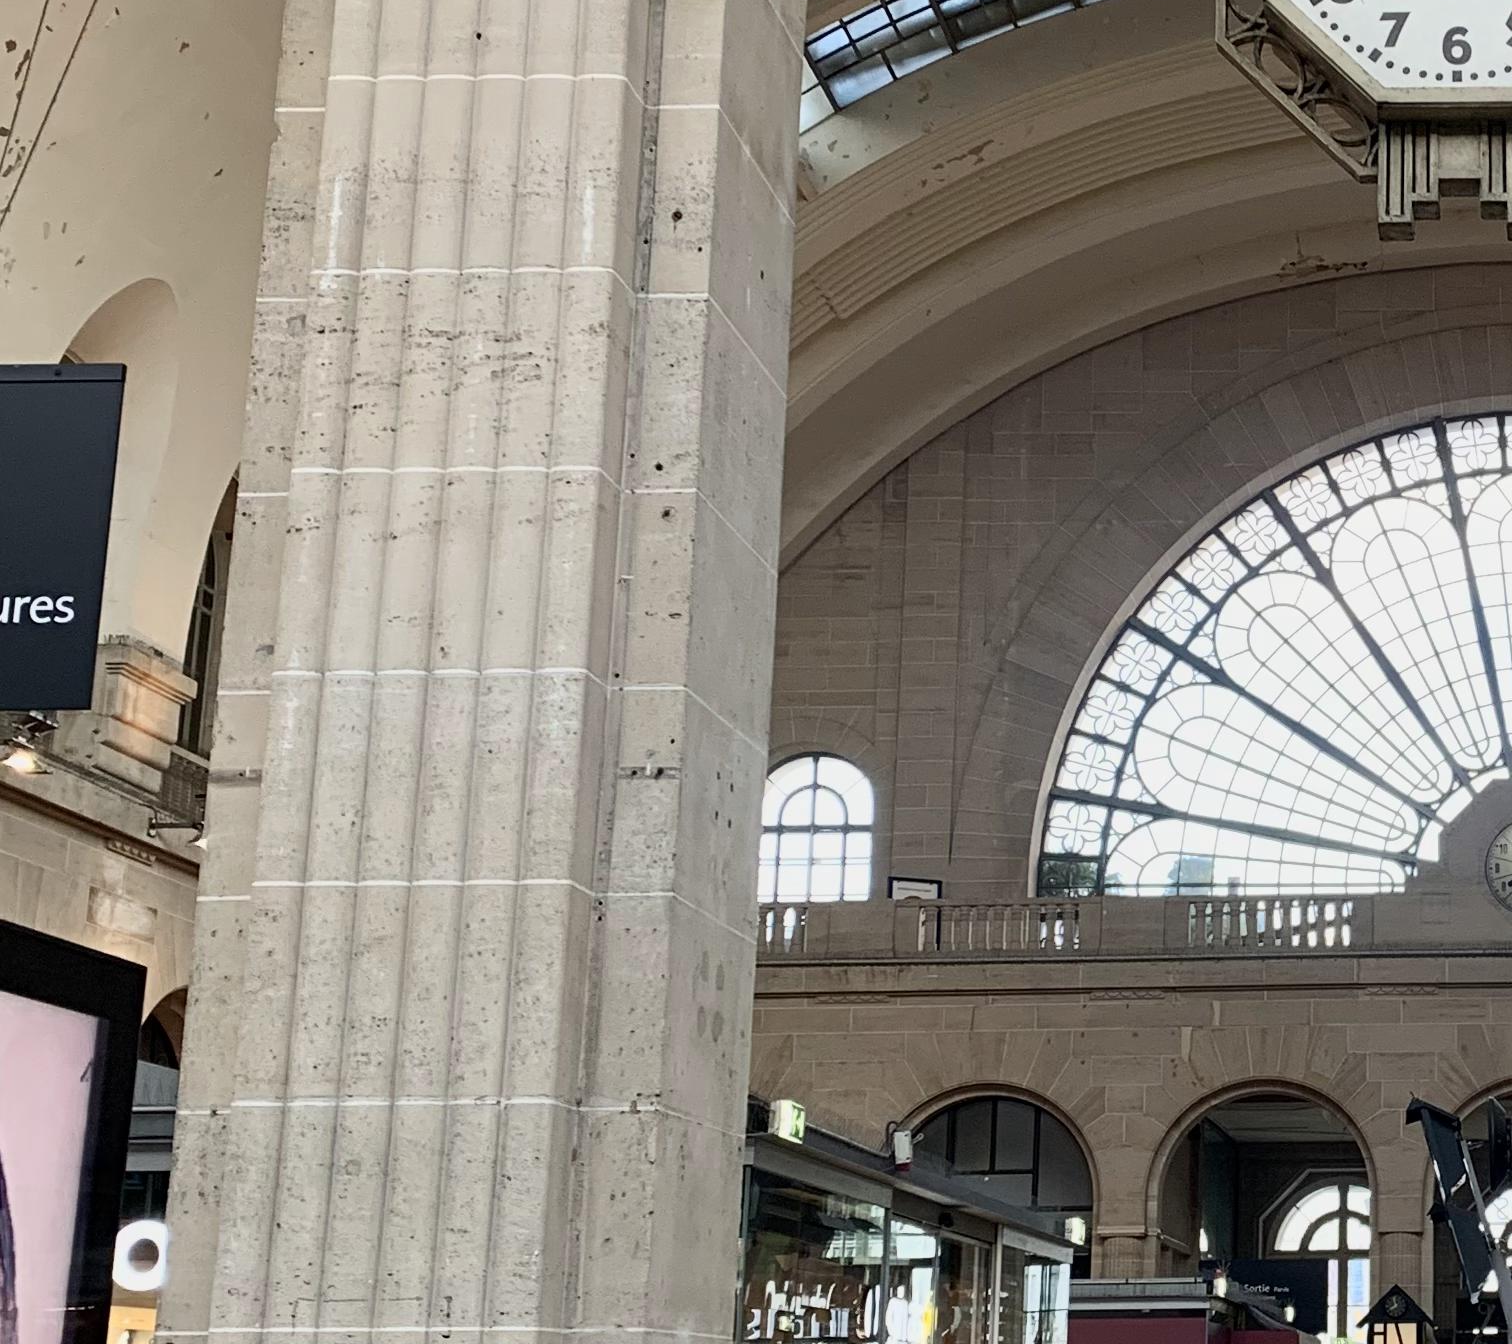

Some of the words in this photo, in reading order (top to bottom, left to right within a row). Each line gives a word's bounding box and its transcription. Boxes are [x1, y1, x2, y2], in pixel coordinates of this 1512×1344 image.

[1380, 11, 1411, 47] 7
[1442, 26, 1472, 65] 6
[1243, 1283, 1271, 1293] Sortie
